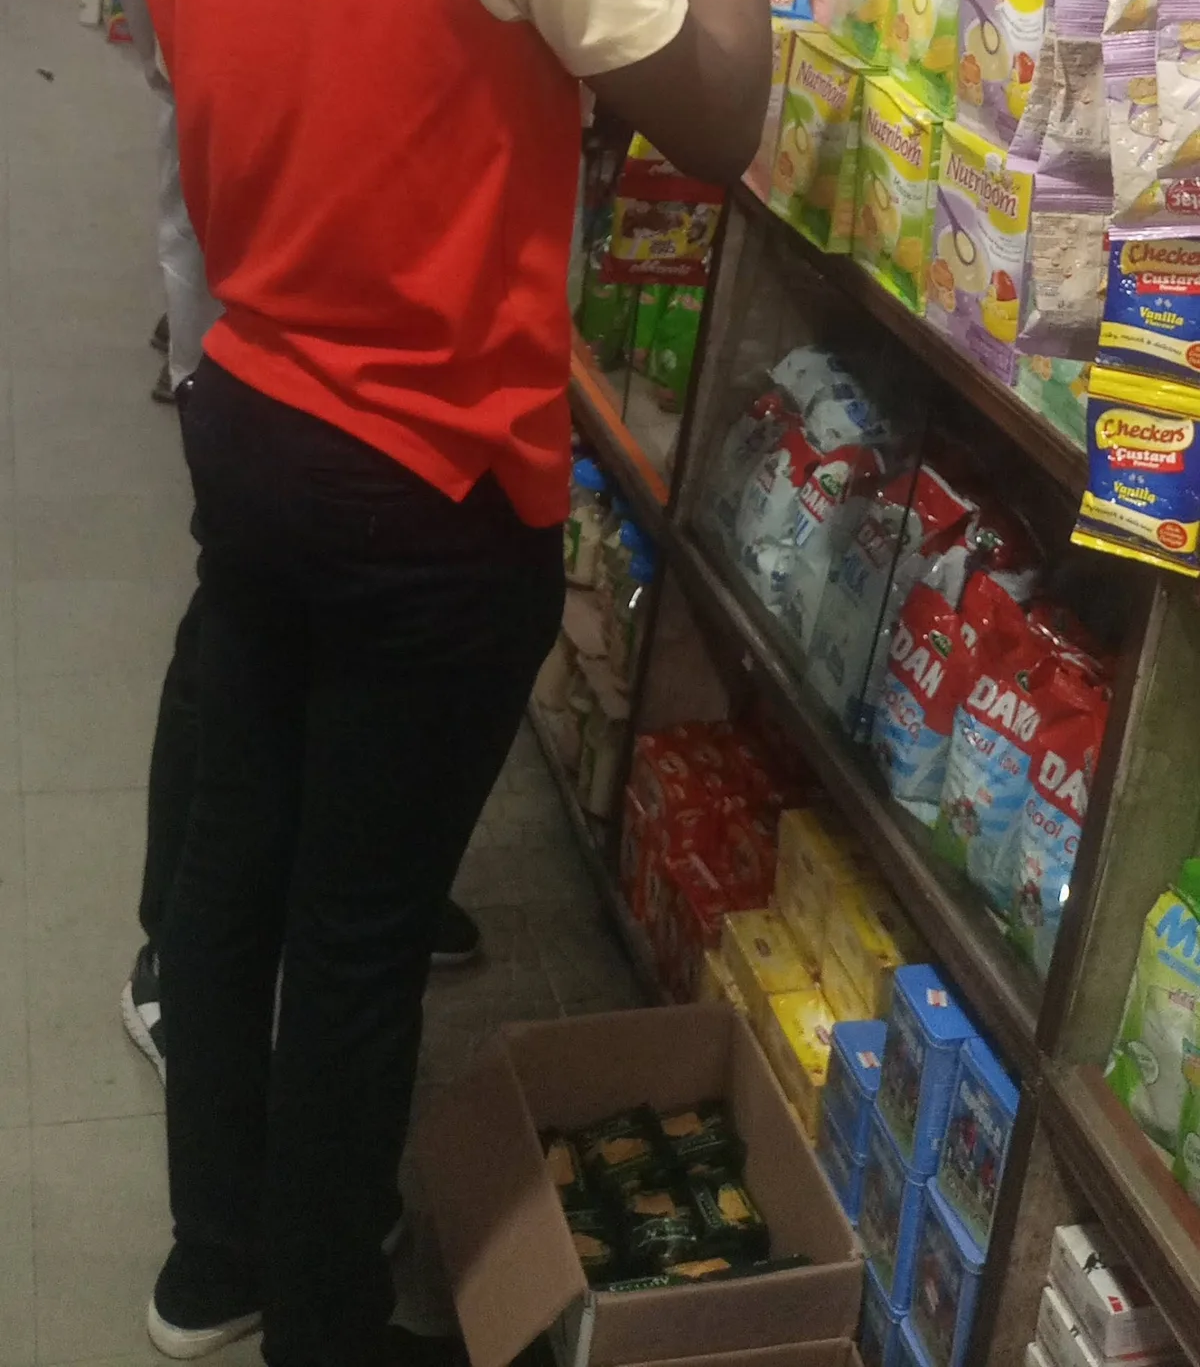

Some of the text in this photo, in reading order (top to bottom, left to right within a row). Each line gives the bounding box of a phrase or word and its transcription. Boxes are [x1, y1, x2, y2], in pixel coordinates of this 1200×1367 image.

[796, 59, 848, 111] Nutribom
[866, 106, 923, 167] Nutribom
[946, 152, 1018, 218] Nutribom
[1128, 241, 1200, 266] Checke
[1139, 305, 1184, 327] Vanilla
[1102, 417, 1186, 444] Checkers
[1115, 447, 1177, 465] Custard
[1113, 480, 1157, 505] Vanilla
[890, 625, 947, 699] DAN
